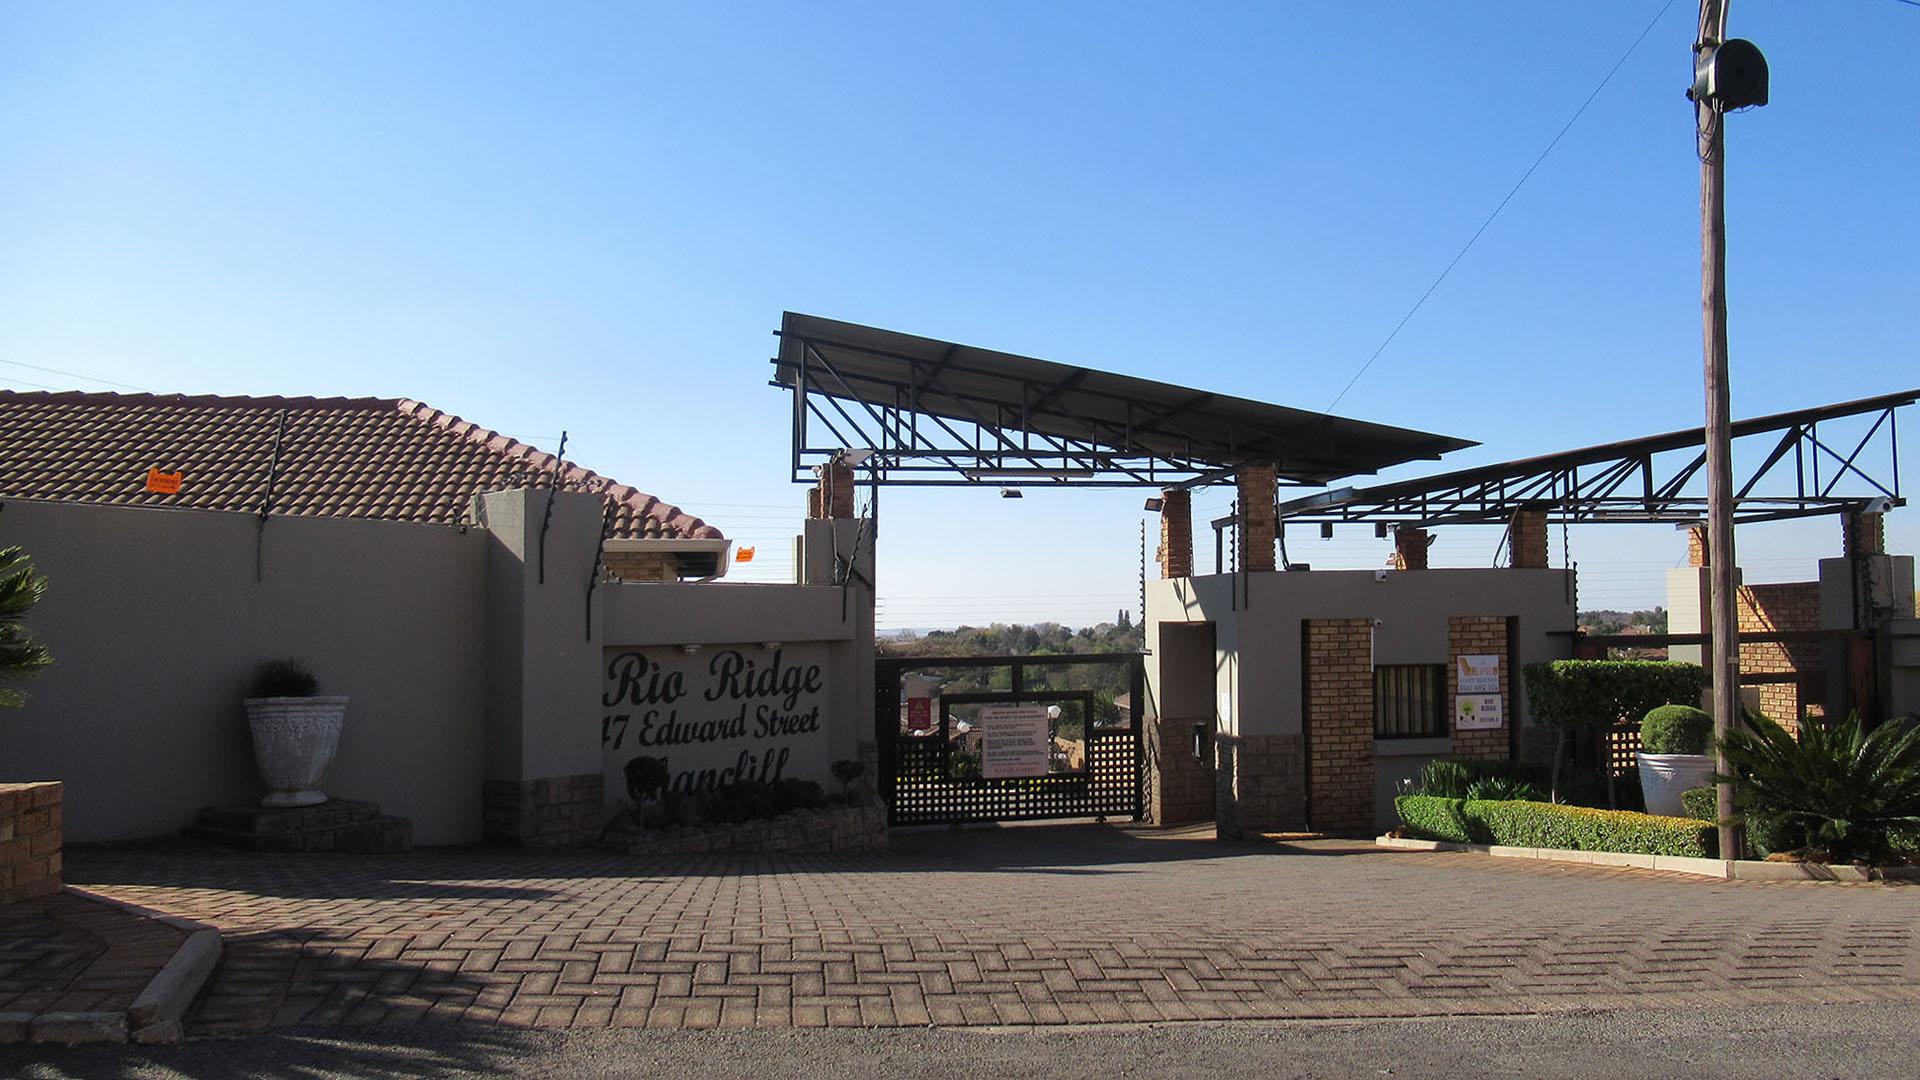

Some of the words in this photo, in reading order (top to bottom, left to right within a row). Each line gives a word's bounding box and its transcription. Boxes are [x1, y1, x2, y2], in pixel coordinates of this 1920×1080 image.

[603, 652, 688, 706] Rio
[704, 649, 823, 711] Ridge
[639, 704, 748, 747] Edward
[754, 705, 821, 739] Street
